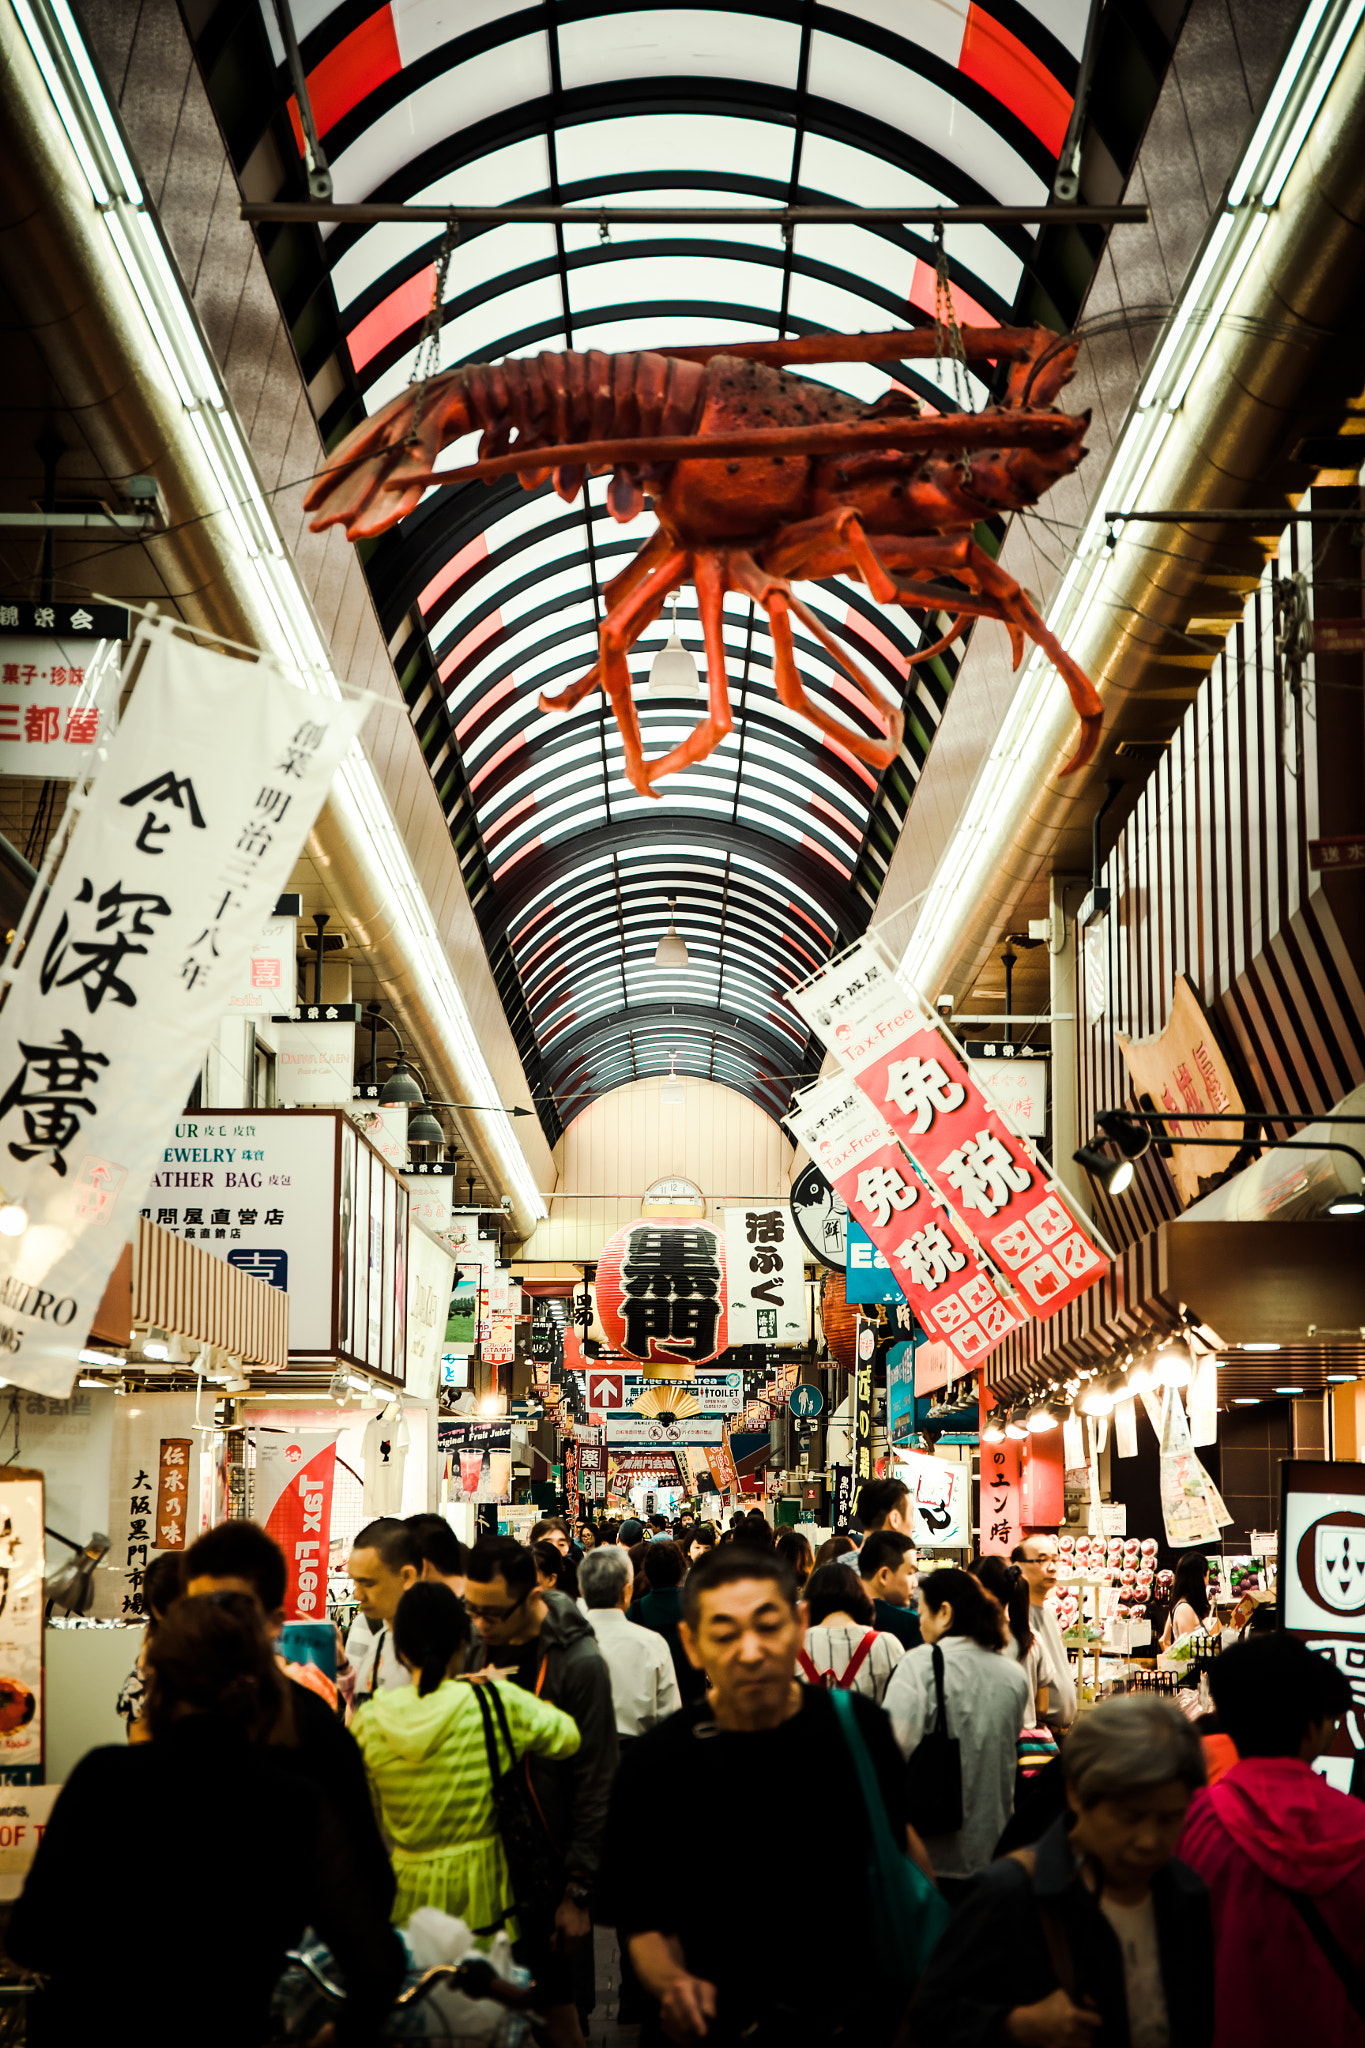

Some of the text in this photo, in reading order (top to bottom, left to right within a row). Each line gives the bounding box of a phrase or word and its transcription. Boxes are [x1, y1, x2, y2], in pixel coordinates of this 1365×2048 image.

[0, 703, 99, 744] 三都屋
[252, 960, 280, 987] 喜
[841, 1009, 915, 1061] Tax-Free
[281, 1053, 349, 1064] DAIWA KAEN
[823, 1128, 881, 1170] Tax-Free
[885, 1056, 1031, 1218] 免税
[225, 1172, 262, 1187] BAG
[268, 1175, 291, 1186] 皮包
[661, 1186, 667, 1194] 11
[671, 1184, 678, 1192] 12
[855, 1166, 967, 1292] 免税
[745, 1210, 785, 1306] 活ふぐ
[636, 1376, 660, 1385] Free
[710, 1388, 739, 1398] TOILET
[469, 1430, 488, 1441] Fruit
[490, 1428, 511, 1438] Juice
[581, 1450, 598, 1468] 薬
[160, 1446, 184, 1546] 伝承乃味
[989, 1452, 1013, 1545] のエン時
[0, 1825, 26, 1847] OF
